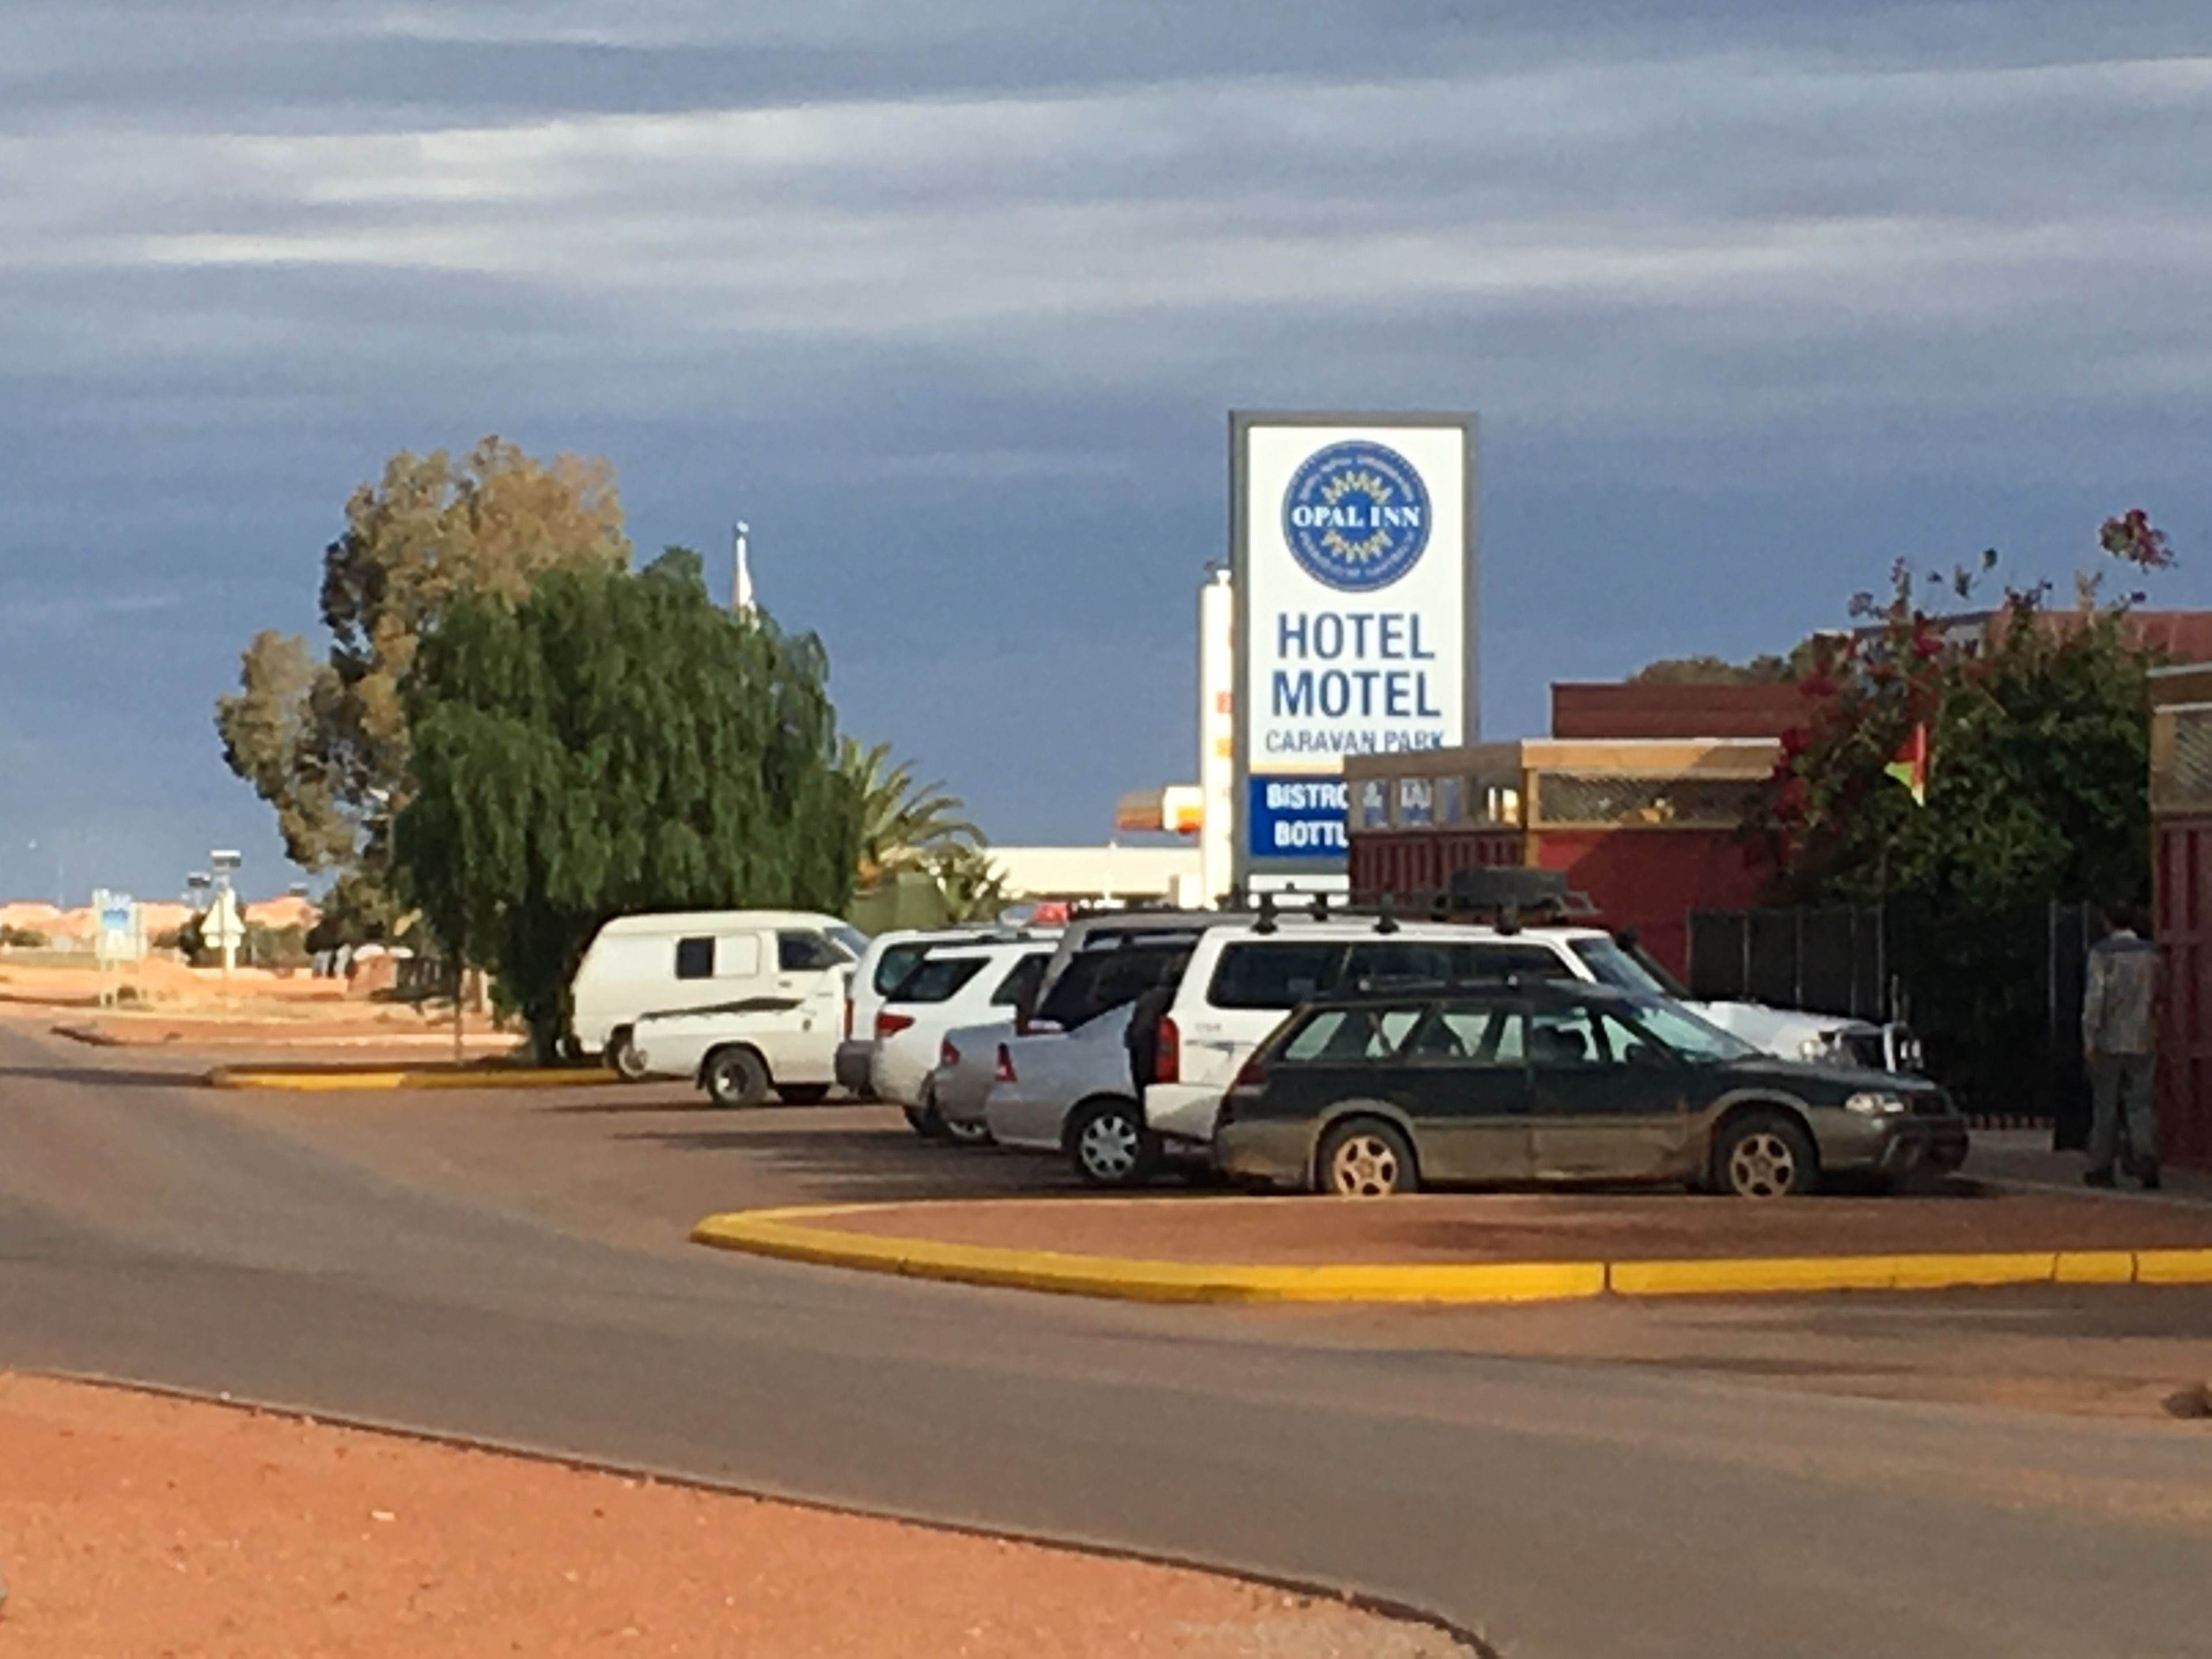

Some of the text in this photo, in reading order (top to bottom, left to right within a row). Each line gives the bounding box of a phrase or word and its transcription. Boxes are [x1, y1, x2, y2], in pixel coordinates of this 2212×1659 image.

[1291, 506, 1421, 527] OPAL INN
[1277, 613, 1435, 659] HOTEL
[1272, 671, 1442, 717] MOTEL
[1266, 730, 1444, 752] CARAVAN PARK
[1274, 820, 1350, 847] BOTTL
